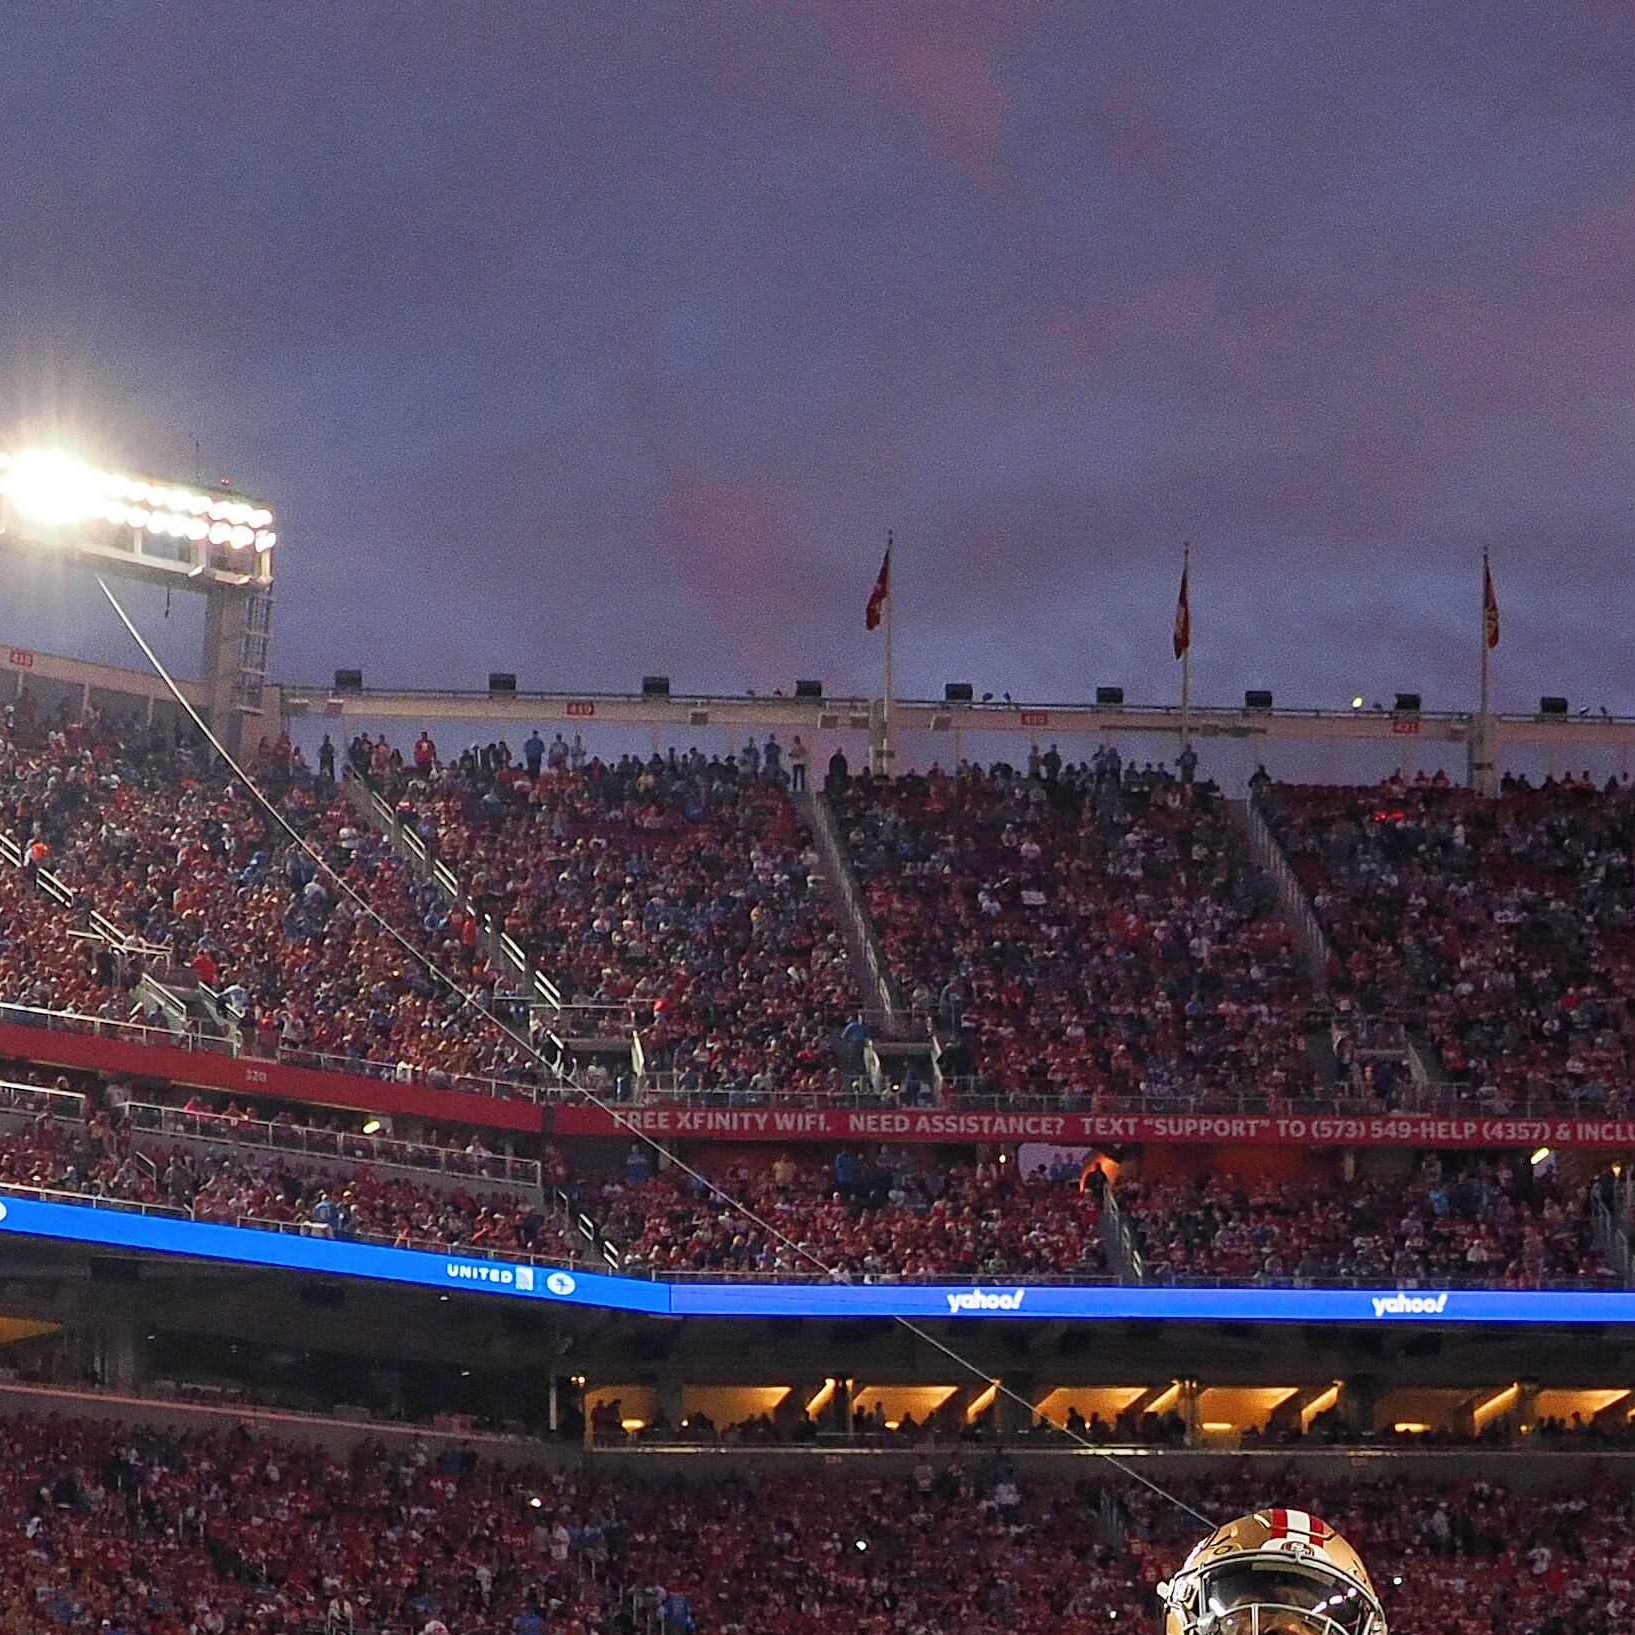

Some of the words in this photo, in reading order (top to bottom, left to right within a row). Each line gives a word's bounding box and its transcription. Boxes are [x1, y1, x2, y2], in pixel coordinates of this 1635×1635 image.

[613, 1112, 669, 1130] FREE
[677, 1112, 768, 1131] XFINITY
[774, 1113, 831, 1132] WIFI.
[849, 1114, 909, 1133] NEED
[916, 1115, 1065, 1135] ASSISTANCE?
[1081, 1117, 1138, 1136] TEXT
[1277, 1120, 1306, 1138] TO
[1311, 1120, 1366, 1141] (573)
[1371, 1121, 1476, 1140] 549-HELP
[1482, 1121, 1551, 1142] (4357)
[1556, 1123, 1571, 1141] &
[447, 1264, 513, 1284] UNITED
[947, 1289, 1024, 1313] yahoo!
[1372, 1293, 1448, 1317] yahoo!
